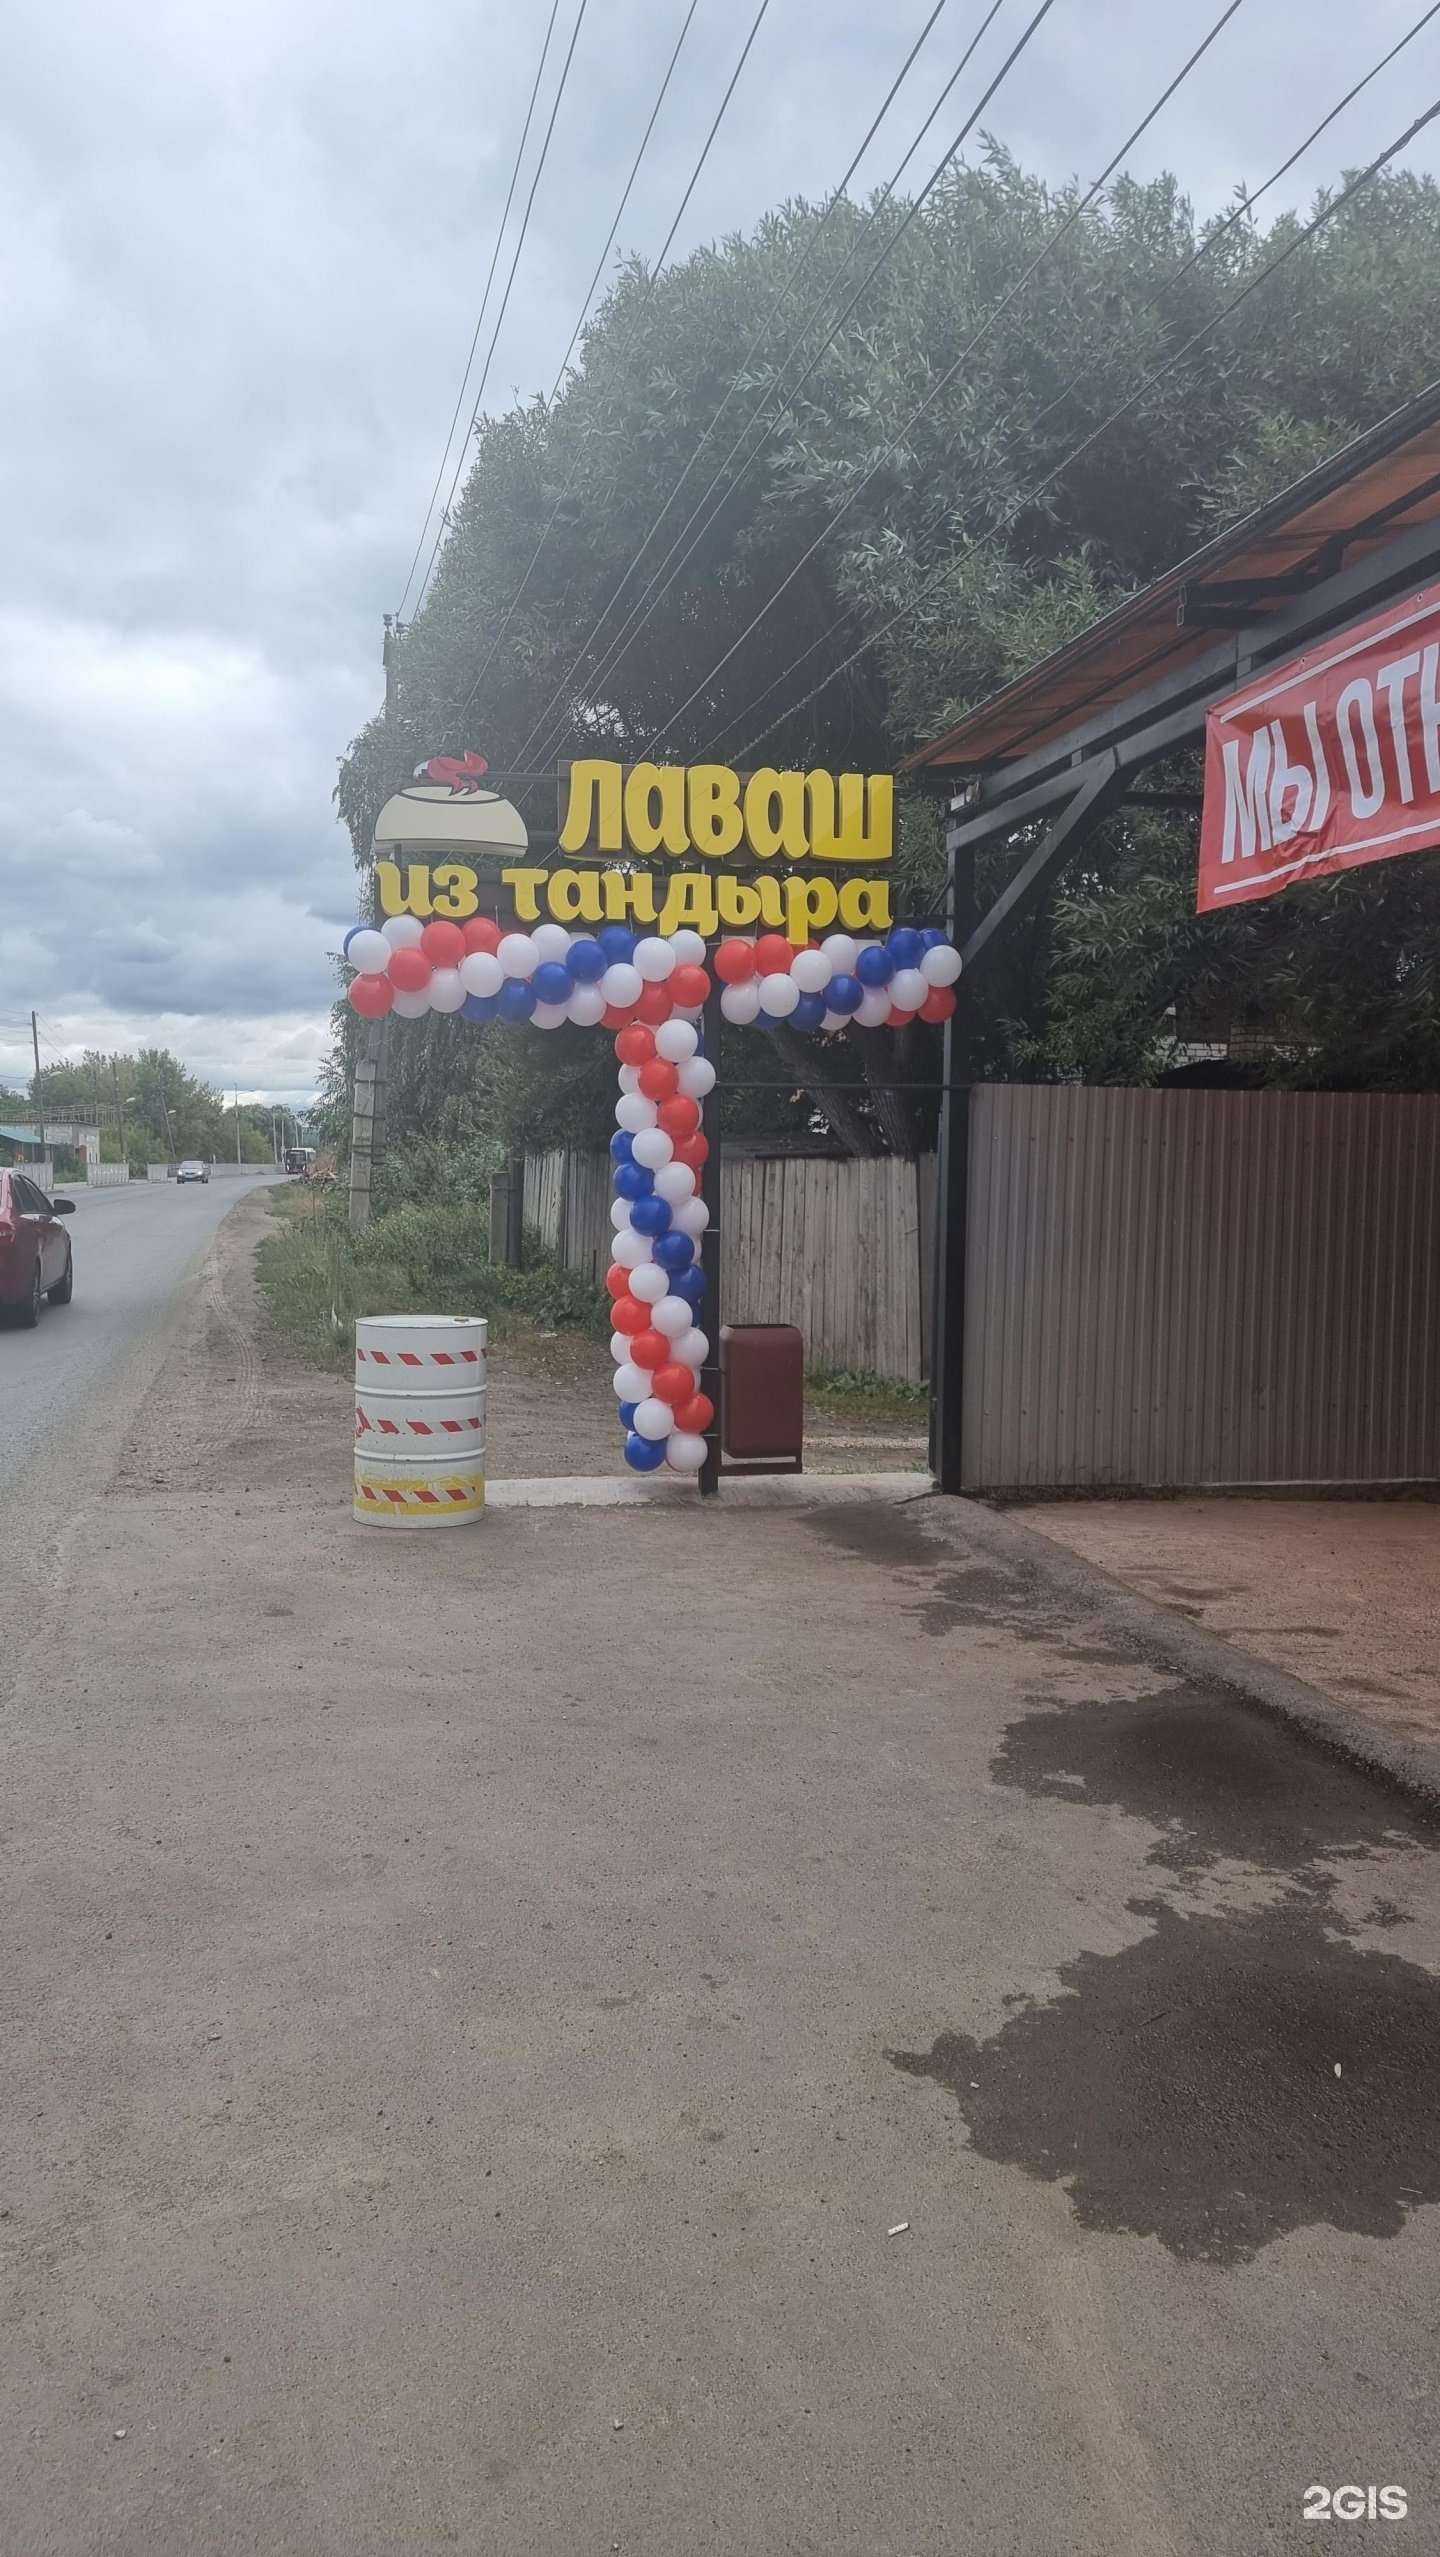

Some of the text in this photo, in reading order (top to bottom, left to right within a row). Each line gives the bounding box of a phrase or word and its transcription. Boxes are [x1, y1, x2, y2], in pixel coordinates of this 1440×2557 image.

[1221, 702, 1331, 864] МЫ
[375, 861, 893, 945] из тандыра
